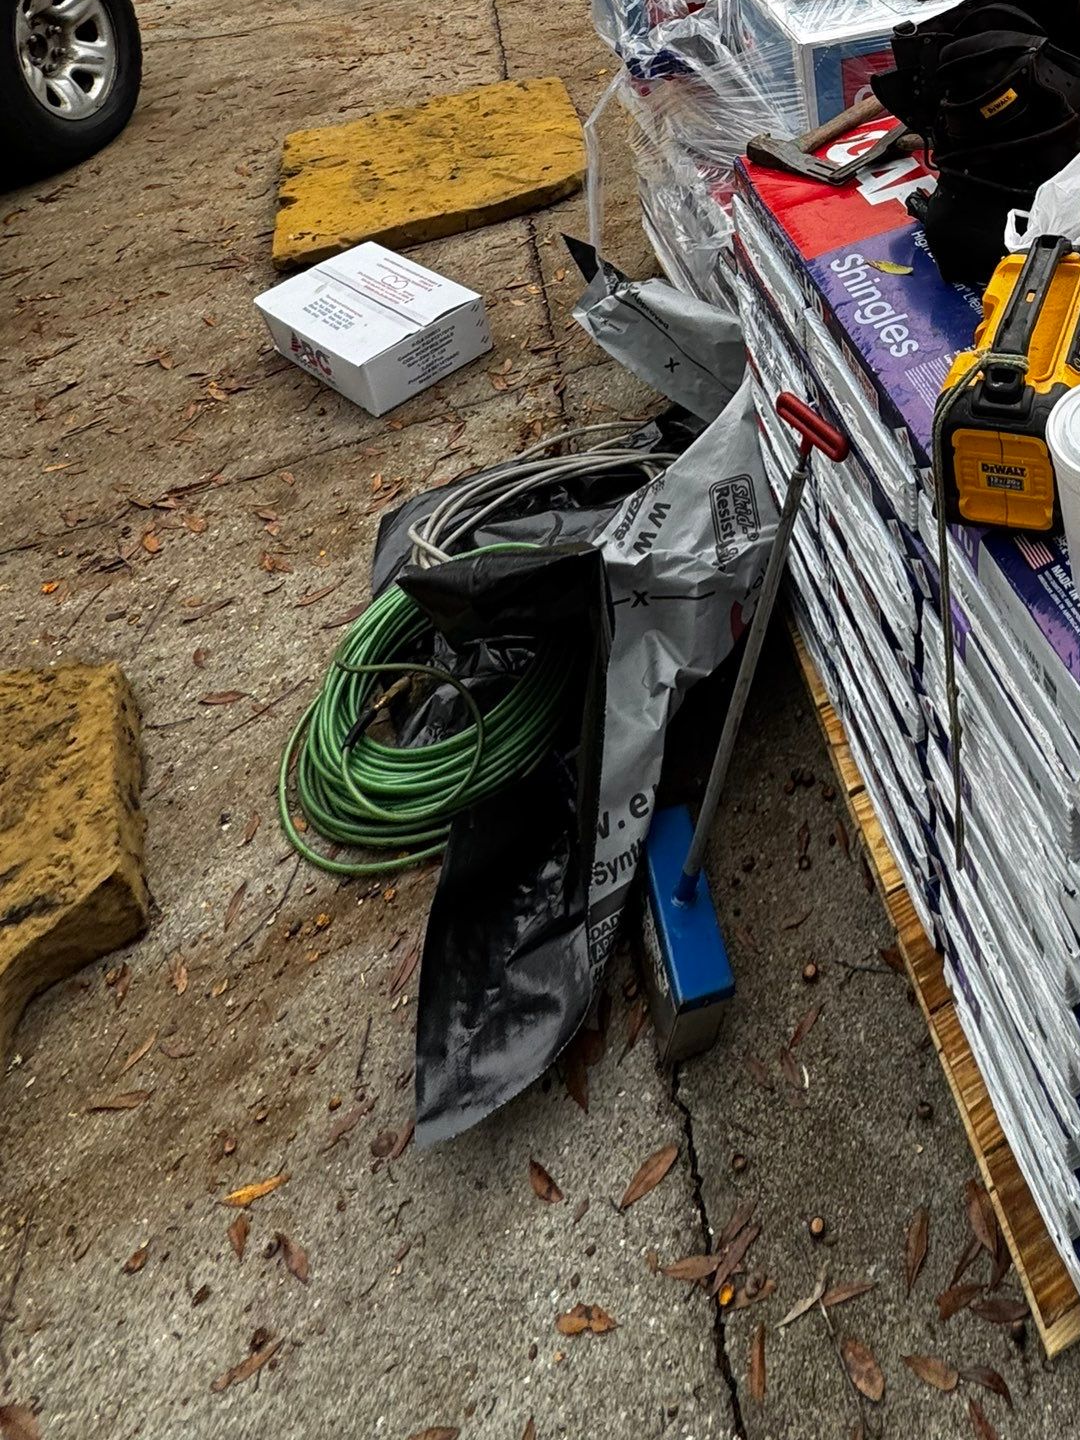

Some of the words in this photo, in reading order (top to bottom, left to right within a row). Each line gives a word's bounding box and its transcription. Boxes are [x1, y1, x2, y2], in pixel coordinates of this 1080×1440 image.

[829, 253, 920, 358] Shingles
[1051, 564, 1072, 590] MADE
[1068, 587, 1080, 602] IN
